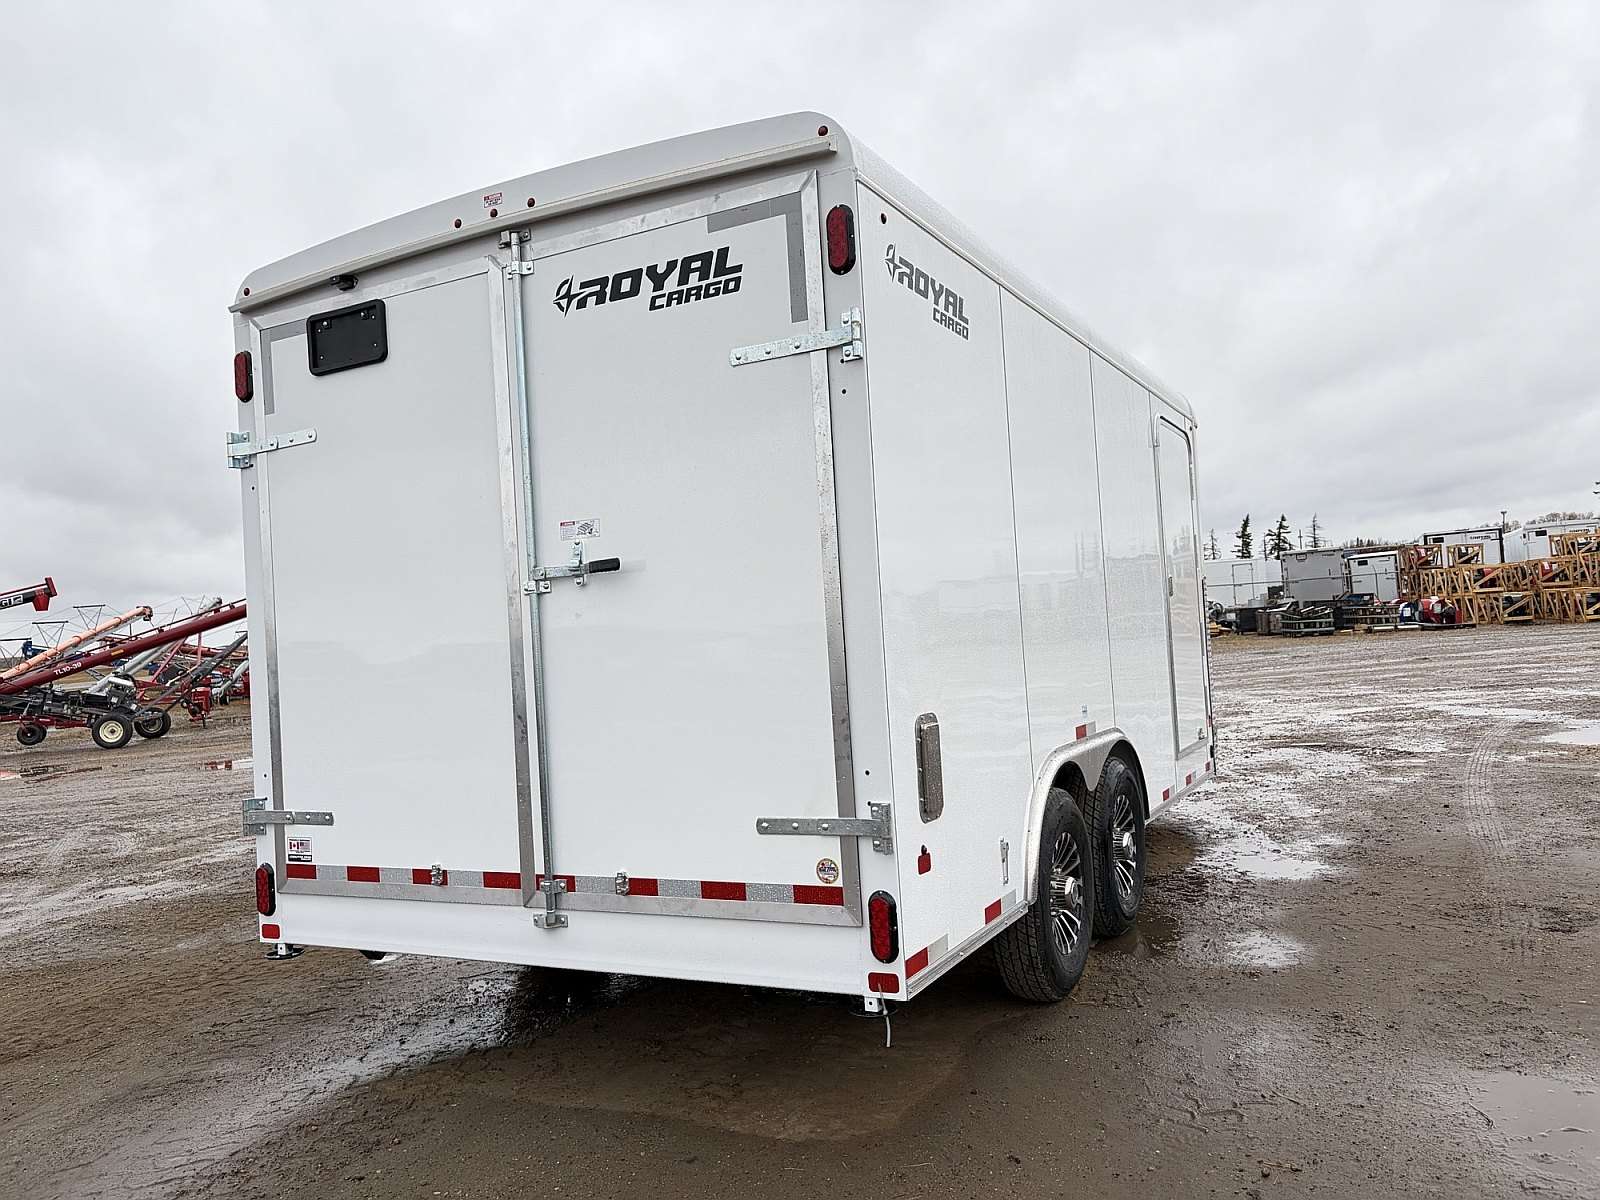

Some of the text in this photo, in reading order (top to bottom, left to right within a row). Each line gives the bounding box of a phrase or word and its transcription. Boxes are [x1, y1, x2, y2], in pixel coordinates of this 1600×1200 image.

[576, 246, 743, 310] ROYAL
[649, 275, 742, 312] CARGO
[898, 256, 969, 325] ROYAL
[933, 307, 969, 340] CARGO
